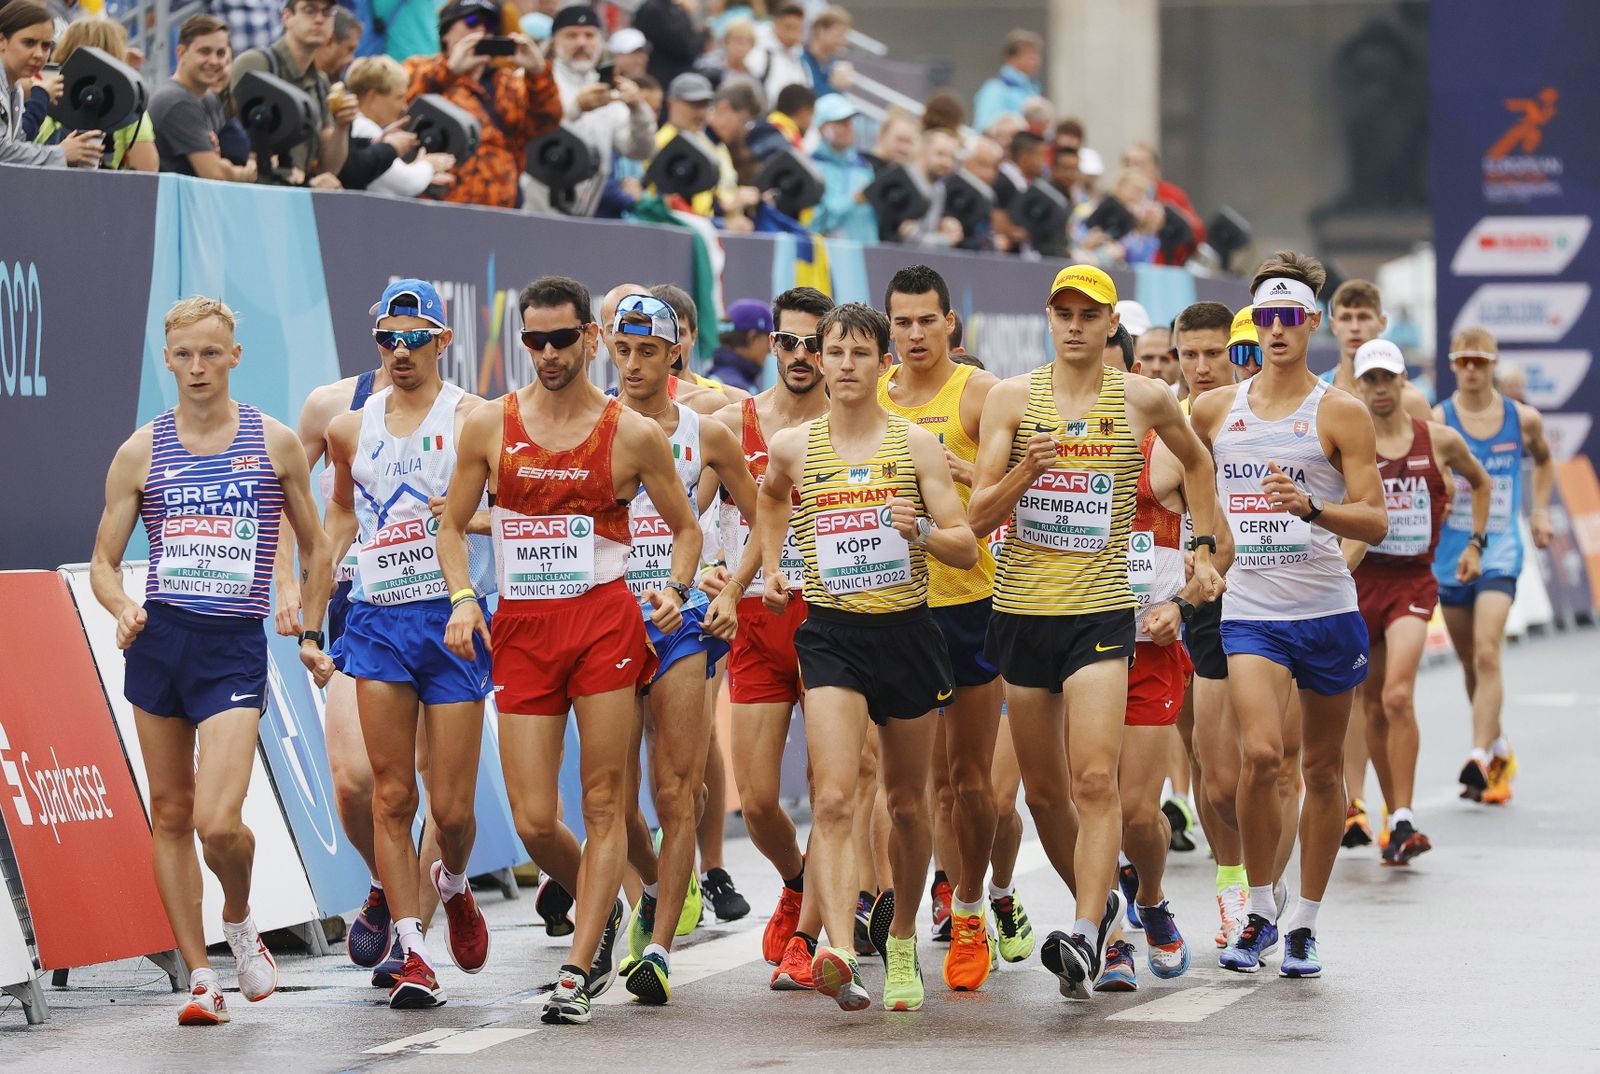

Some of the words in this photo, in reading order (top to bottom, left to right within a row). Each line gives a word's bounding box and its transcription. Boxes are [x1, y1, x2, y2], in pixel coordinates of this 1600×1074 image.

[1056, 274, 1098, 286] GERMANY
[0, 260, 47, 397] 022
[1056, 444, 1116, 457] RMANY
[385, 457, 422, 476] IALIA
[516, 466, 590, 481] ESPAÑA
[1224, 463, 1306, 484] SLOVAIA
[1031, 473, 1087, 490] PAR
[1384, 475, 1428, 492] TVIA
[164, 480, 259, 506] GREAT
[816, 486, 900, 508] GERMANY
[166, 500, 259, 518] BRITAIN
[1019, 496, 1108, 515] BREMBACH
[1230, 496, 1282, 510] SPA
[166, 518, 232, 536] SPAR
[632, 519, 671, 534] AR
[816, 512, 878, 533] SPAR
[1056, 515, 1068, 525] 28
[504, 520, 566, 537] SPAR
[836, 537, 882, 555] KÖPP
[1022, 529, 1069, 548] MUNICH
[1074, 537, 1104, 550] 2022
[1260, 535, 1272, 544] 56
[165, 543, 252, 562] WILKINSON
[378, 546, 434, 569] STANO
[516, 543, 578, 560] MARTÍN
[628, 544, 672, 558] RTUNA
[1280, 553, 1308, 565] 2022
[197, 559, 211, 569] 27
[540, 562, 552, 572] 17
[646, 560, 658, 569] 44
[854, 554, 867, 565] 32
[1127, 559, 1152, 572] RERA
[402, 565, 416, 576] 46
[841, 565, 860, 574] RUN
[163, 578, 211, 592] MUNICH
[216, 583, 247, 594] 2022
[389, 578, 408, 588] RUN
[629, 581, 662, 593] NICH
[824, 576, 872, 591] MUNICH
[876, 570, 906, 585] 2022
[372, 585, 422, 604] MUNICH
[425, 581, 448, 595] 202
[510, 585, 555, 596] MUNICH
[560, 583, 590, 595] 2022
[1137, 594, 1151, 604] 22
[21, 746, 113, 844] Sparkasse
